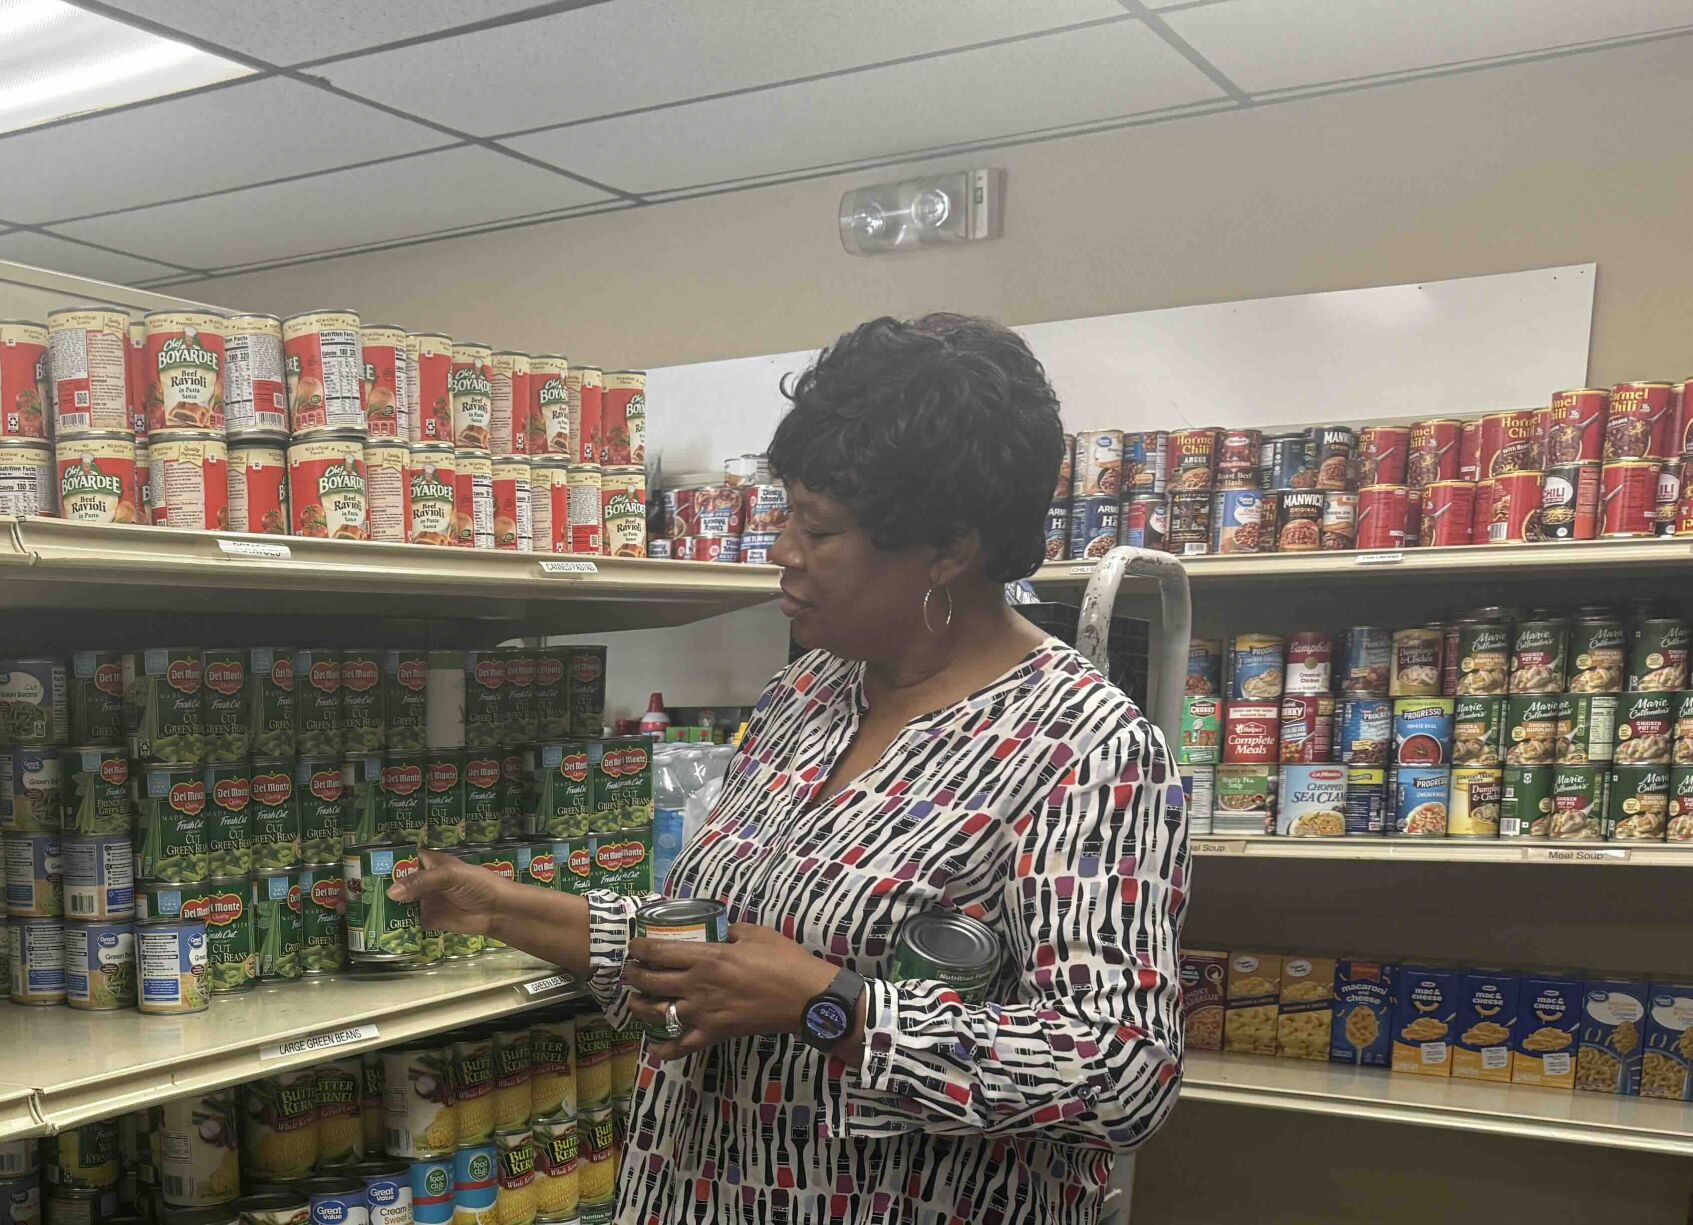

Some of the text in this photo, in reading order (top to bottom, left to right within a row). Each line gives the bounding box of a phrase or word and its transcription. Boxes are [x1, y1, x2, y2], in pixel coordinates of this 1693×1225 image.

[163, 337, 183, 351] Chef
[158, 348, 219, 370] BOYARDEE
[455, 369, 473, 378] Chef
[171, 376, 207, 388] Ravioli
[1609, 401, 1637, 413] Chili
[1182, 445, 1209, 455] Chili
[65, 465, 81, 478] Chef
[325, 465, 343, 477] Chef
[61, 475, 121, 495] BOYARDEE
[610, 495, 627, 505] Chef
[1284, 494, 1323, 509] MANWICH
[72, 501, 107, 513] Ravioli
[334, 500, 362, 511] Ravioli
[413, 508, 444, 519] Ravioli
[617, 524, 642, 533] Ravioli
[547, 563, 595, 572] CANNED PASTAS
[1520, 631, 1551, 641] Marie
[172, 670, 184, 679] Del
[1457, 703, 1484, 712] Marie
[1630, 698, 1668, 710] Marie
[1403, 708, 1442, 720] PROGRESSO
[165, 723, 192, 735] GREEN
[1243, 726, 1263, 734] Helper
[1229, 735, 1275, 745] Complete
[1235, 745, 1268, 754] Meals
[625, 756, 646, 764] Monte
[400, 774, 420, 782] Monte
[1557, 775, 1585, 785] Marie
[254, 783, 289, 793] Del Monte
[314, 780, 326, 788] Del
[1307, 783, 1343, 791] CHOPPED
[174, 792, 187, 801] Del
[218, 789, 230, 797] Del
[469, 792, 484, 800] Fresh
[1292, 792, 1315, 803] SEA
[388, 800, 404, 808] Fresh
[477, 804, 491, 812] CUT
[257, 809, 288, 821] Fresh Cut
[316, 806, 332, 816] Fresh
[396, 812, 412, 820] CUT
[558, 806, 580, 816] GREEN
[177, 820, 195, 831] Fresh
[220, 815, 247, 826] Fresh Cut
[324, 819, 337, 828] CUT
[266, 824, 283, 833] CUT
[186, 834, 200, 844] CUT
[229, 829, 244, 839] CUT
[211, 839, 237, 850] GREEN
[167, 845, 194, 855] GREEN
[1548, 851, 1604, 860] Meal Soup
[315, 888, 327, 897] Del
[214, 903, 240, 912] Monte
[184, 909, 196, 918] Del
[390, 918, 414, 929] GREEN
[222, 930, 237, 939] Cut
[212, 944, 231, 953] CUT
[224, 952, 247, 962] BEANS
[940, 973, 971, 981] Nutrition
[531, 975, 572, 992] GREEN BEANS
[1341, 983, 1388, 995] macaroni
[1346, 995, 1381, 1004] cheese
[1412, 994, 1442, 1002] cheese
[1472, 998, 1503, 1006] cheese
[1534, 1003, 1566, 1011] cheese
[278, 1029, 362, 1055] LARGE GREEN BEANS
[472, 1158, 488, 1170] food
[473, 1165, 488, 1175] club
[551, 1167, 567, 1176] Whole
[429, 1174, 445, 1184] food
[429, 1180, 445, 1190] club
[370, 1188, 394, 1198] Great
[376, 1194, 395, 1202] Value
[317, 1207, 342, 1217] Great
[379, 1207, 406, 1217] Cream
[383, 1215, 407, 1225] Sweet
